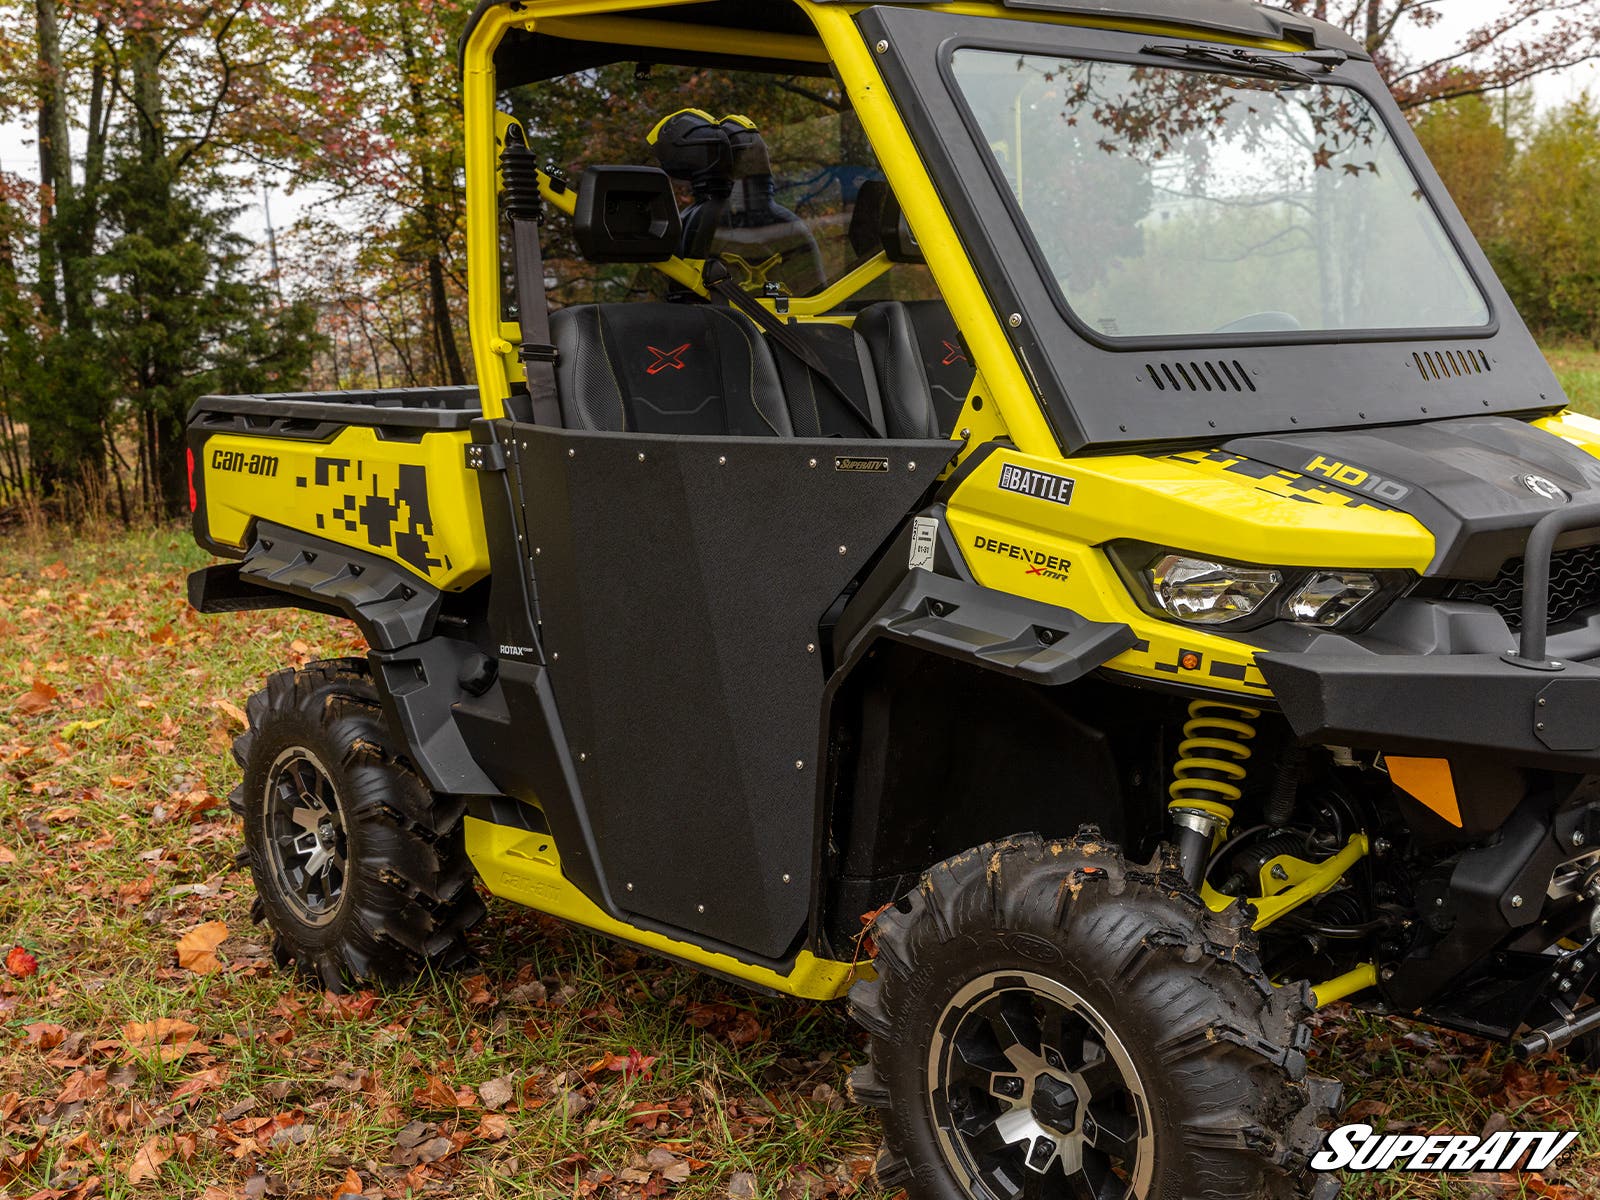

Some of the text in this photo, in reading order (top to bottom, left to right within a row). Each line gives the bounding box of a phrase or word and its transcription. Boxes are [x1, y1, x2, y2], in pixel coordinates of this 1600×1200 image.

[211, 449, 279, 477] can-am
[1304, 455, 1409, 501] HD10
[1009, 467, 1071, 503] BATTLE
[973, 535, 1072, 573] DEFENDER
[500, 644, 524, 656] ROTAX
